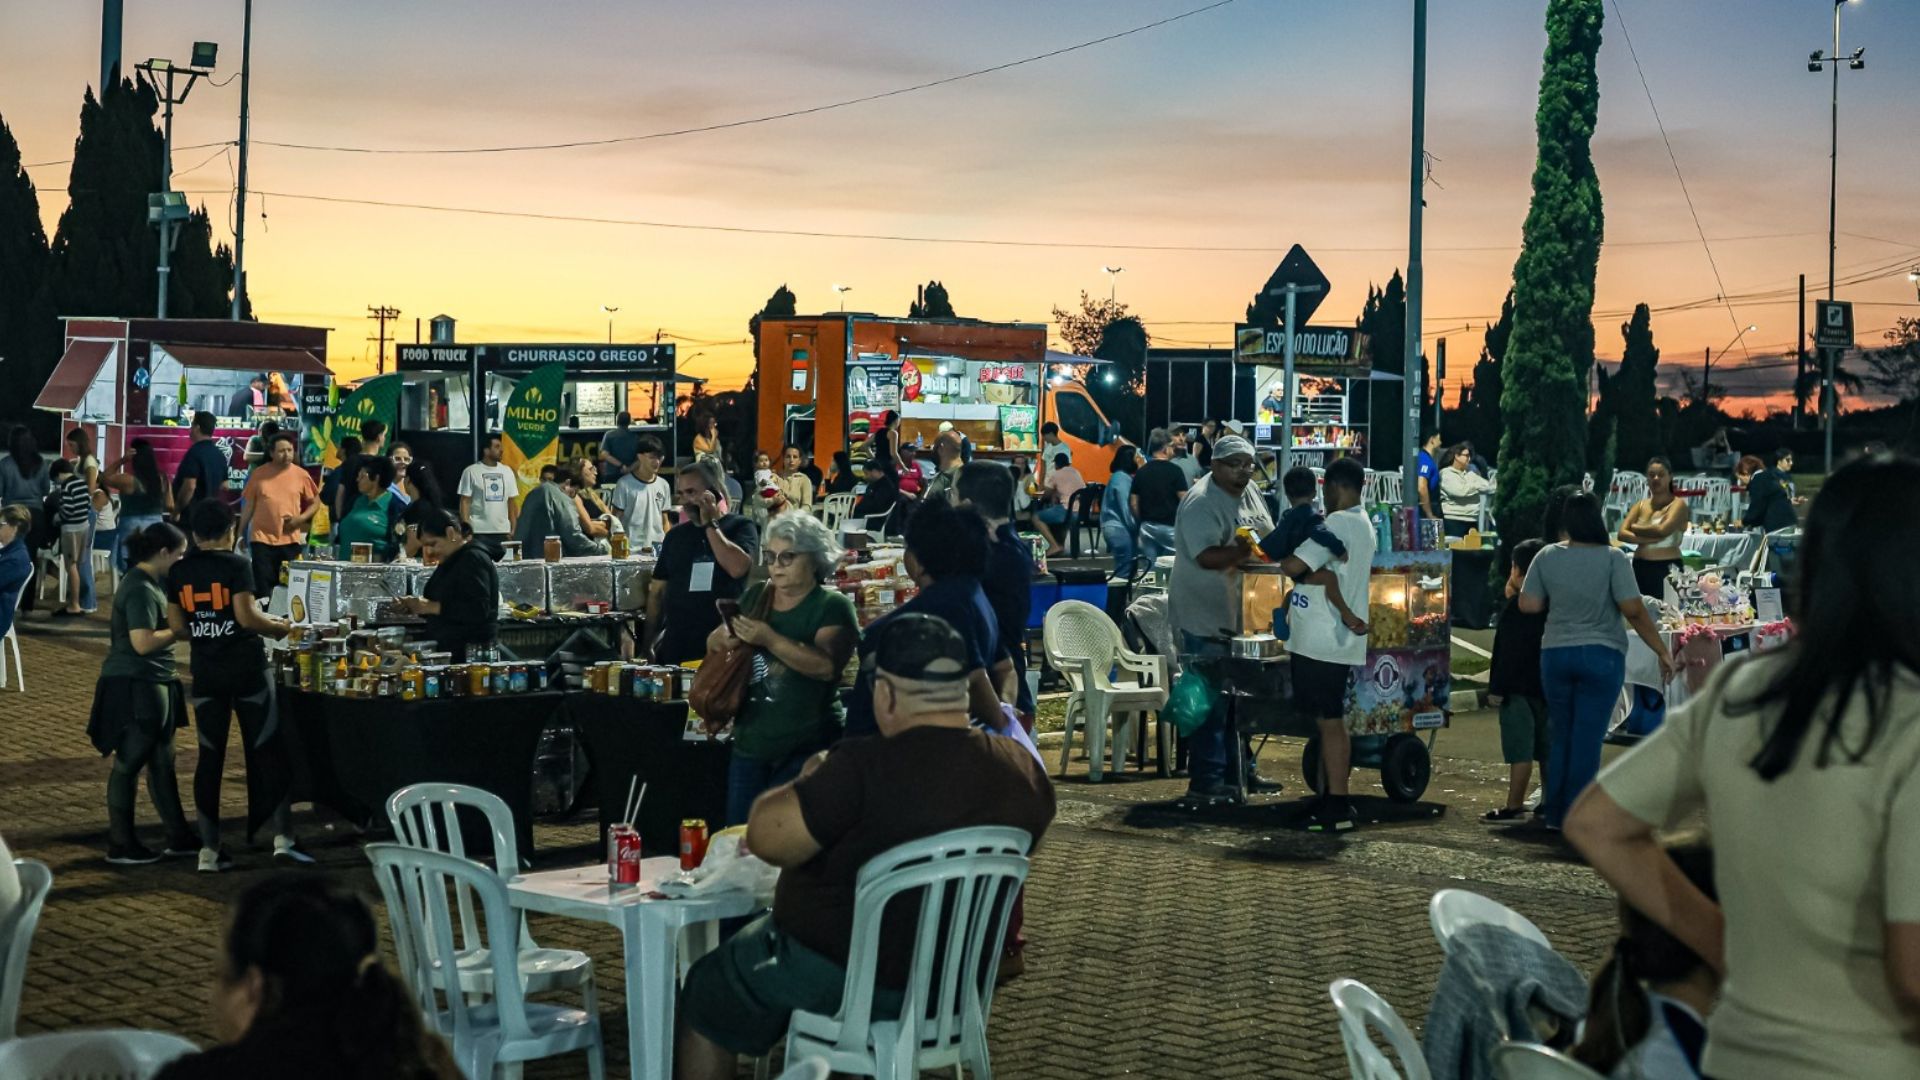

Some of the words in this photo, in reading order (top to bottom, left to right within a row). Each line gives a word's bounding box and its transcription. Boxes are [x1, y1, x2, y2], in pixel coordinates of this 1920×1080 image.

[1266, 332, 1302, 354] ESPO
[1302, 332, 1317, 355] DO
[402, 348, 429, 361] FOOD
[432, 349, 467, 362] TRUCK
[508, 350, 596, 362] CHURRASCO
[600, 350, 648, 362] GREGO
[507, 405, 557, 422] MILHO
[336, 415, 362, 432] MIL
[517, 422, 546, 432] VERDE
[558, 441, 600, 463] LAC
[1291, 451, 1324, 467] PETINHO
